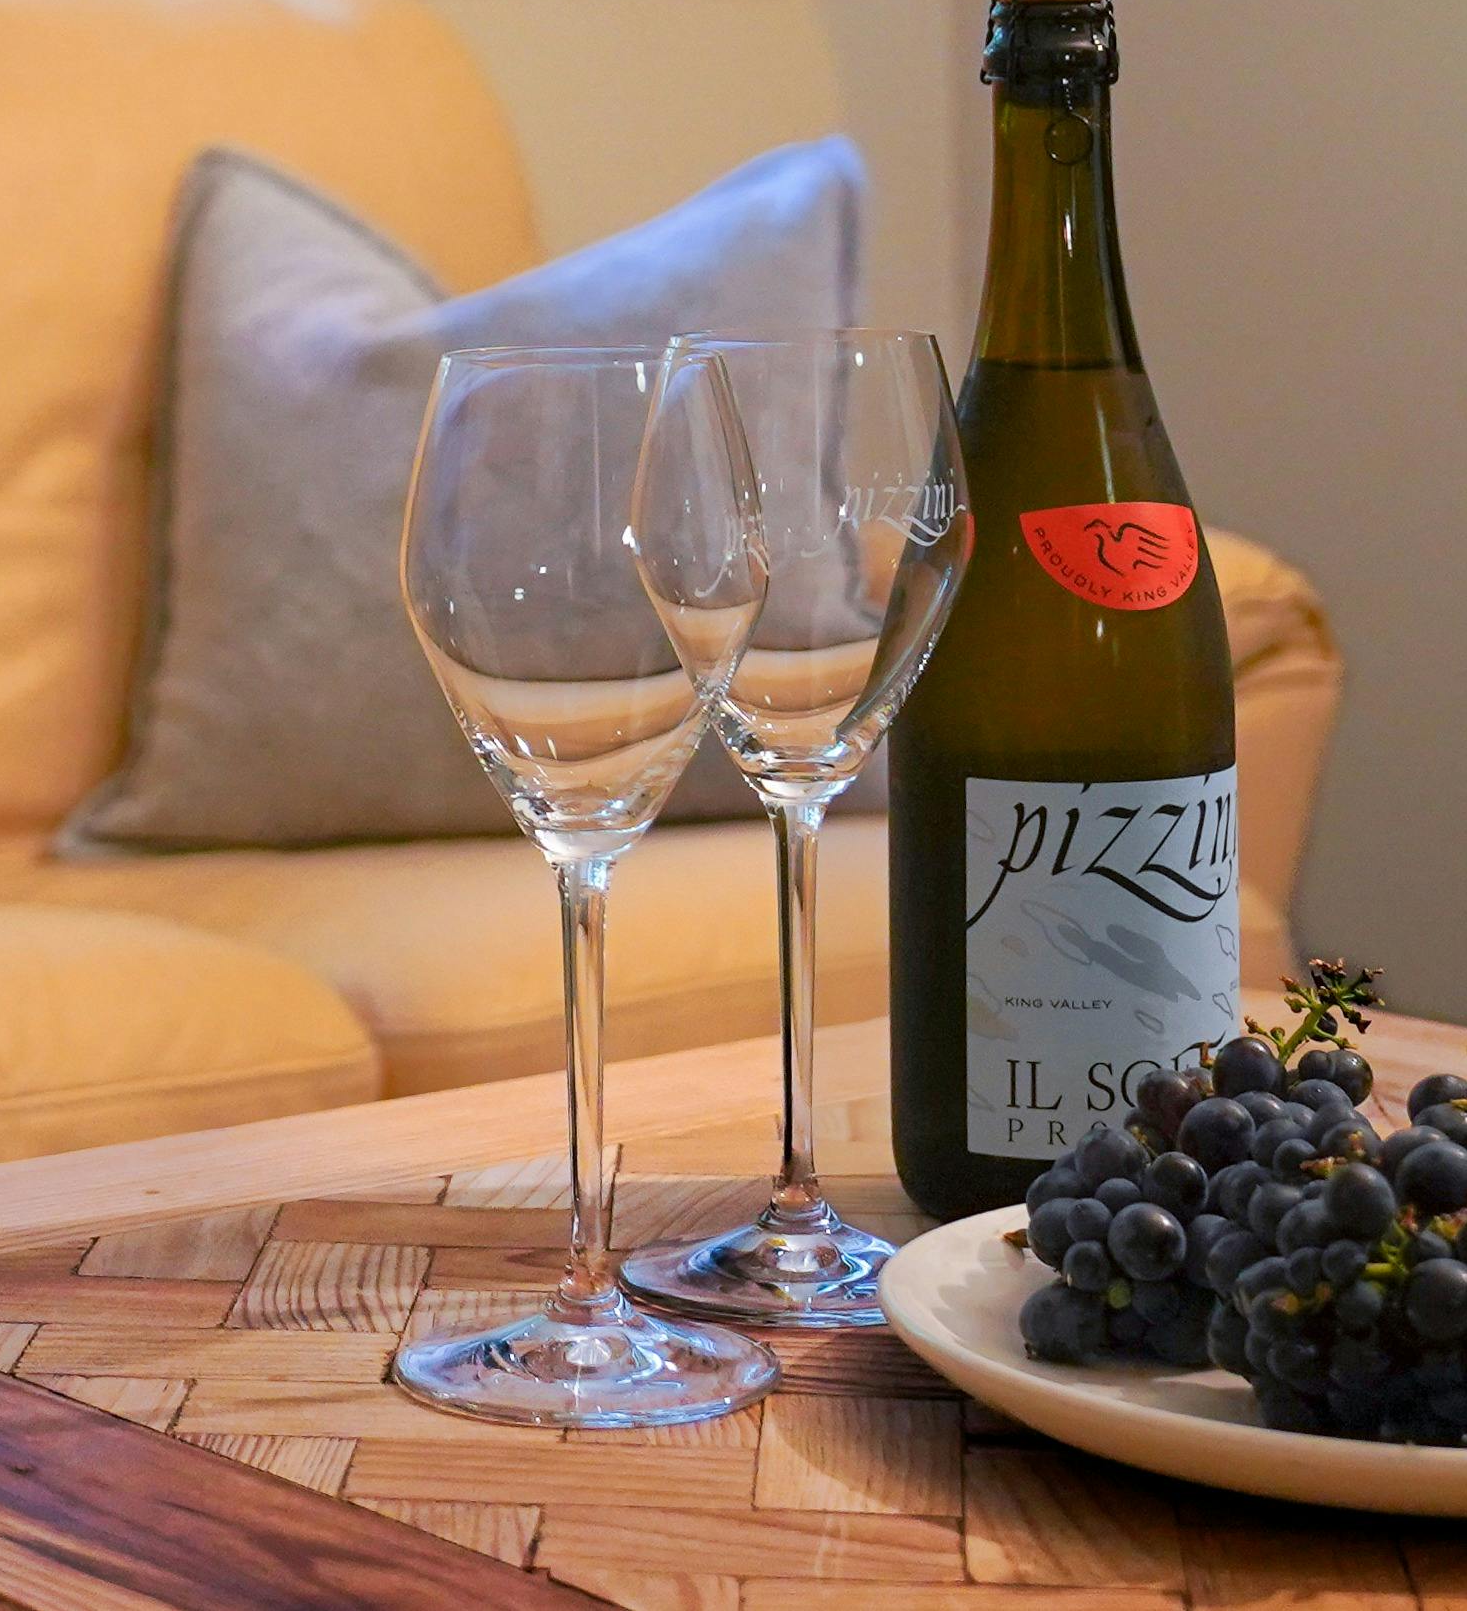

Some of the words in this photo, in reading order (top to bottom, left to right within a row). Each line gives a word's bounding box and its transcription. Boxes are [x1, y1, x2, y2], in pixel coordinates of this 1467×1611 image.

[801, 467, 966, 558] pizzini
[1034, 526, 1112, 598] PROUDLY
[1122, 587, 1168, 602] KING
[1170, 528, 1195, 588] VALLEY
[1004, 996, 1044, 1009] KING
[1049, 999, 1114, 1010] VALLEY
[1006, 1059, 1063, 1111] IL
